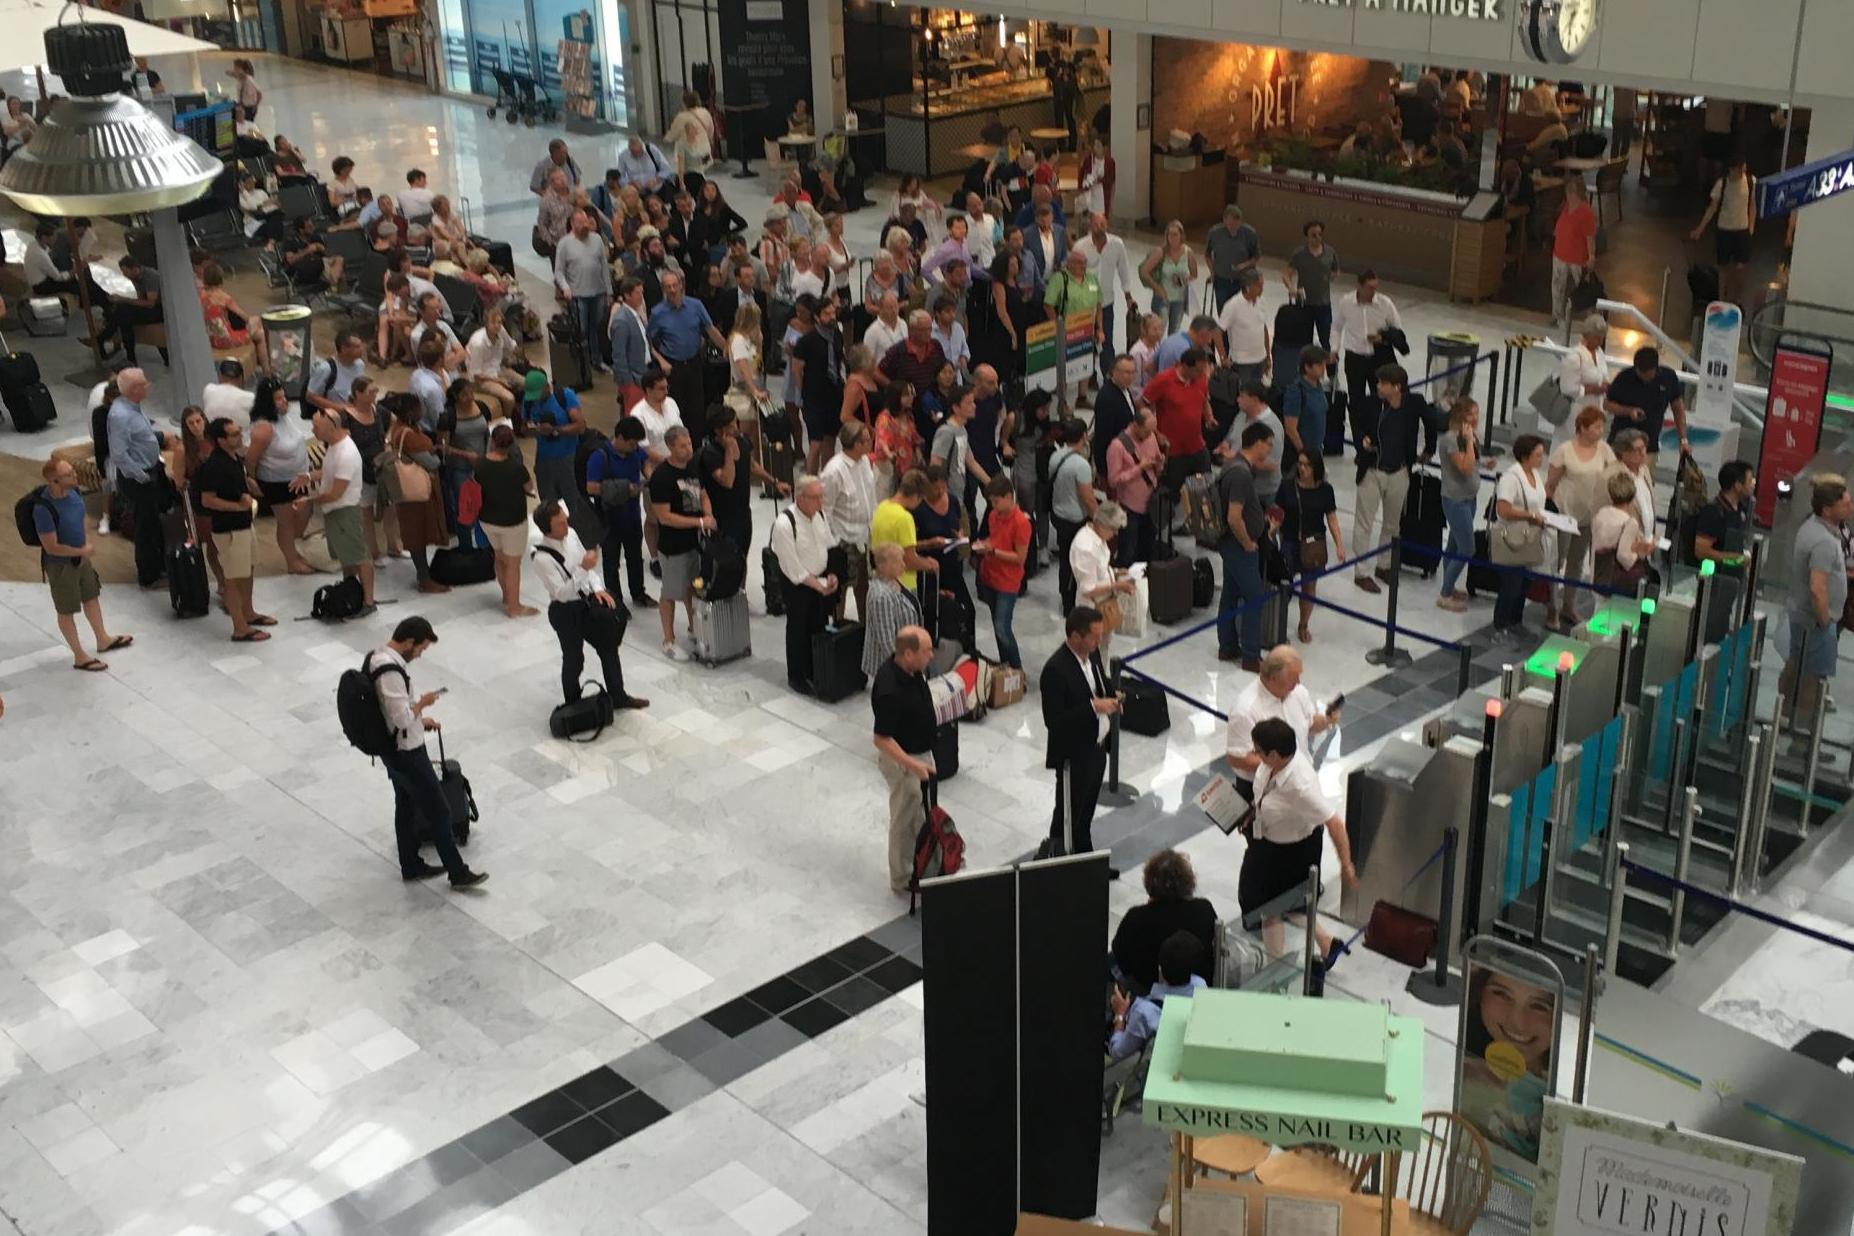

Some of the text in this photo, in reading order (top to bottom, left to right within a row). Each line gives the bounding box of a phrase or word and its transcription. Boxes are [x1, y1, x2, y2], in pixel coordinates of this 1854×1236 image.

[1251, 73, 1300, 132] PRET
[1157, 1104, 1403, 1147] EXPRESS NAIL BAR
[1596, 1179, 1729, 1236] VERNIS
[1597, 1156, 1733, 1207] Mademoiselle
